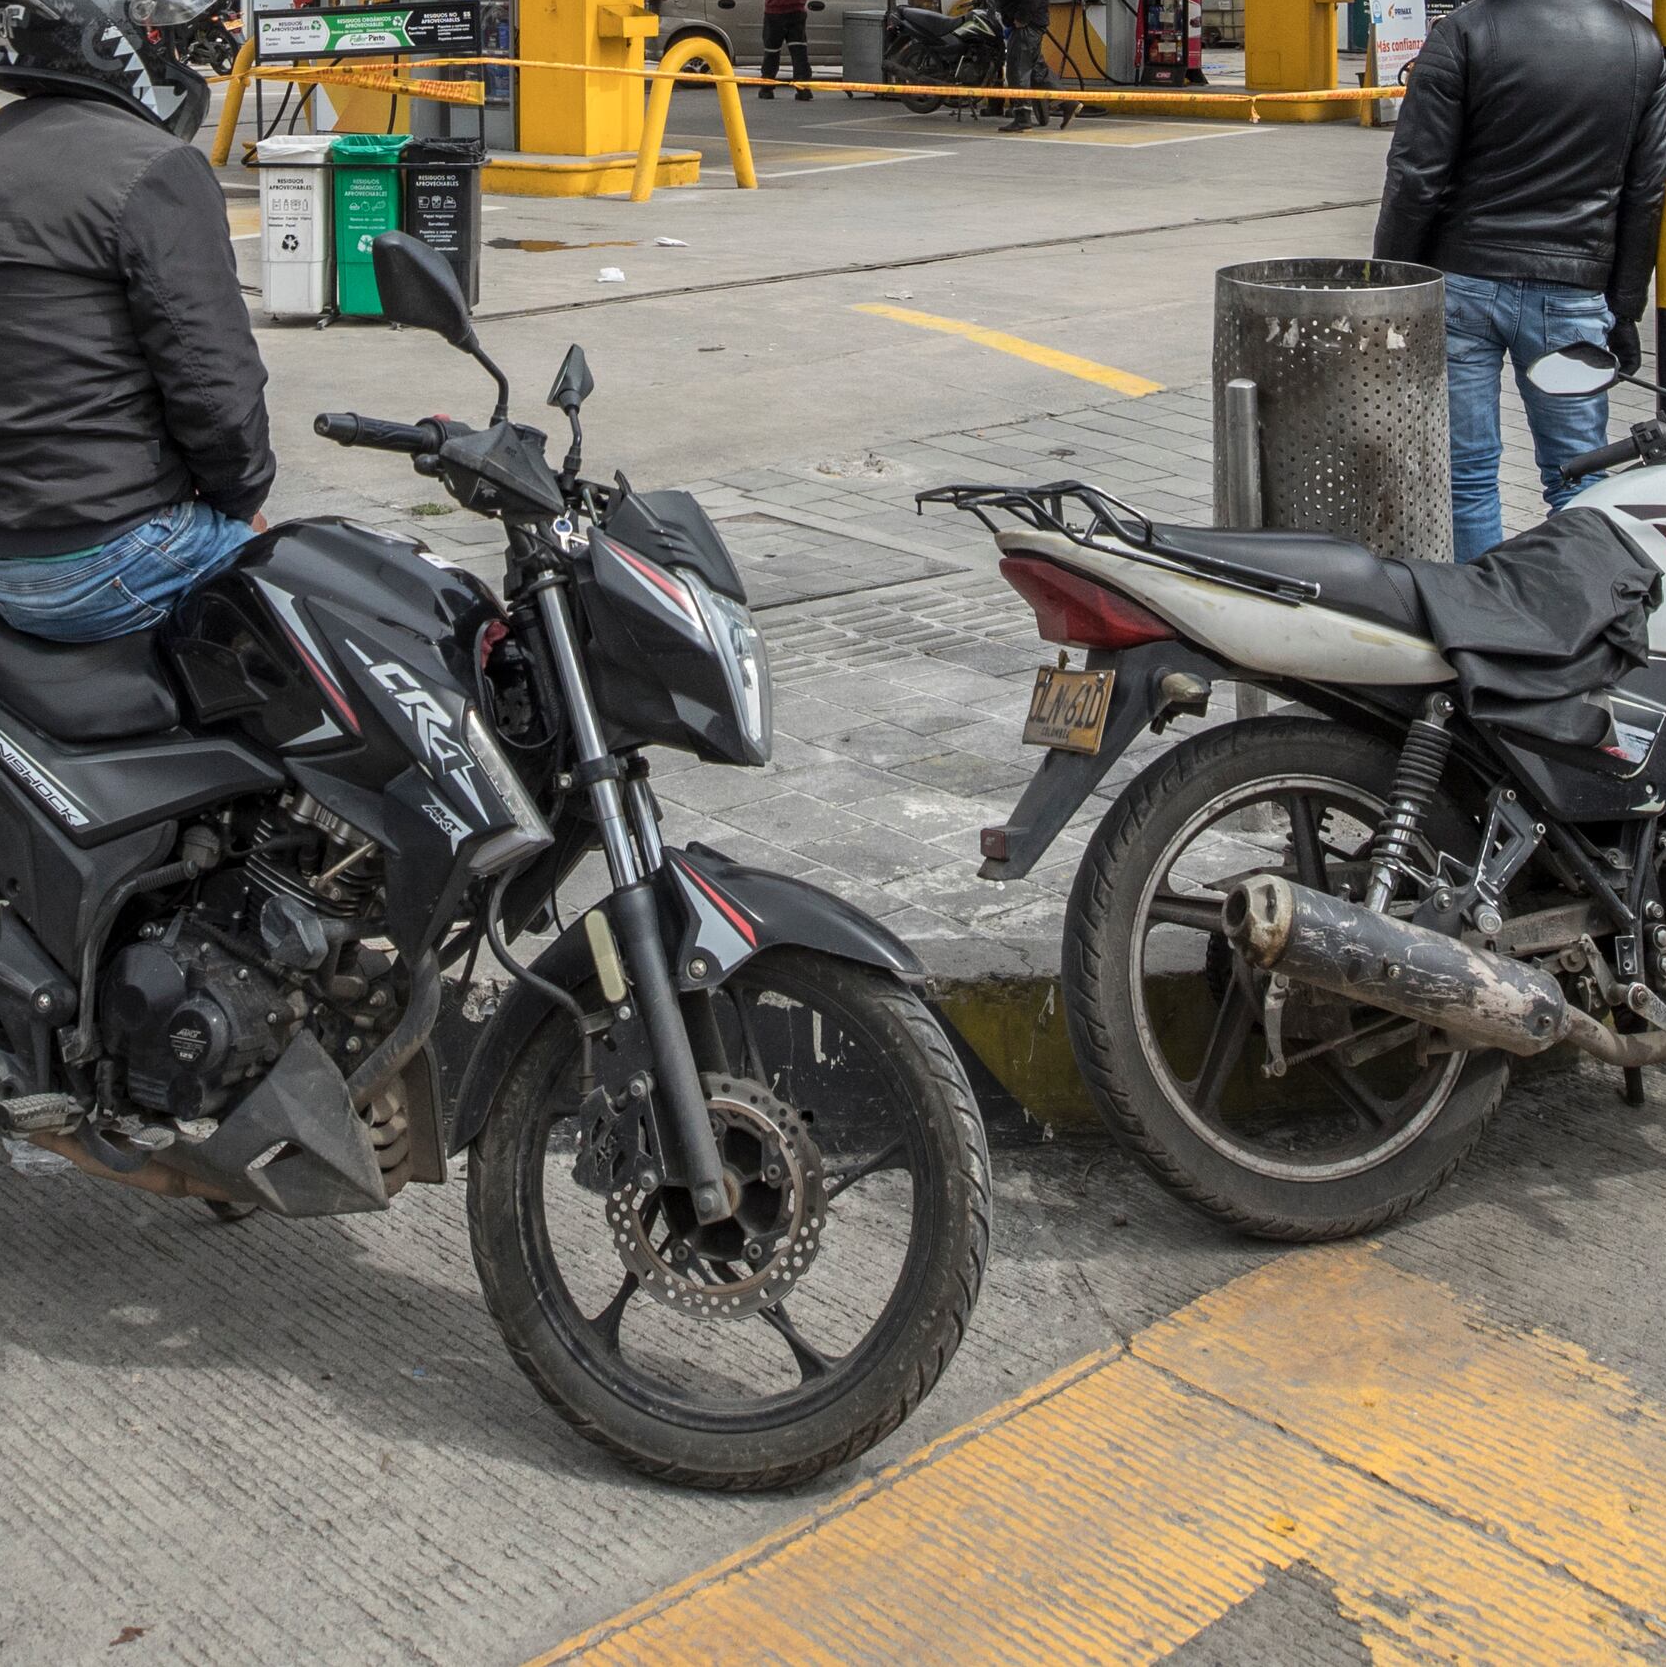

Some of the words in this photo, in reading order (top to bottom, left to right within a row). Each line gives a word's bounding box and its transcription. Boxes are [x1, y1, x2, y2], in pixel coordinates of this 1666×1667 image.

[1394, 8, 1412, 16] PRIMAX
[362, 15, 391, 23] ORGÁNICOS
[1377, 40, 1390, 53] Más
